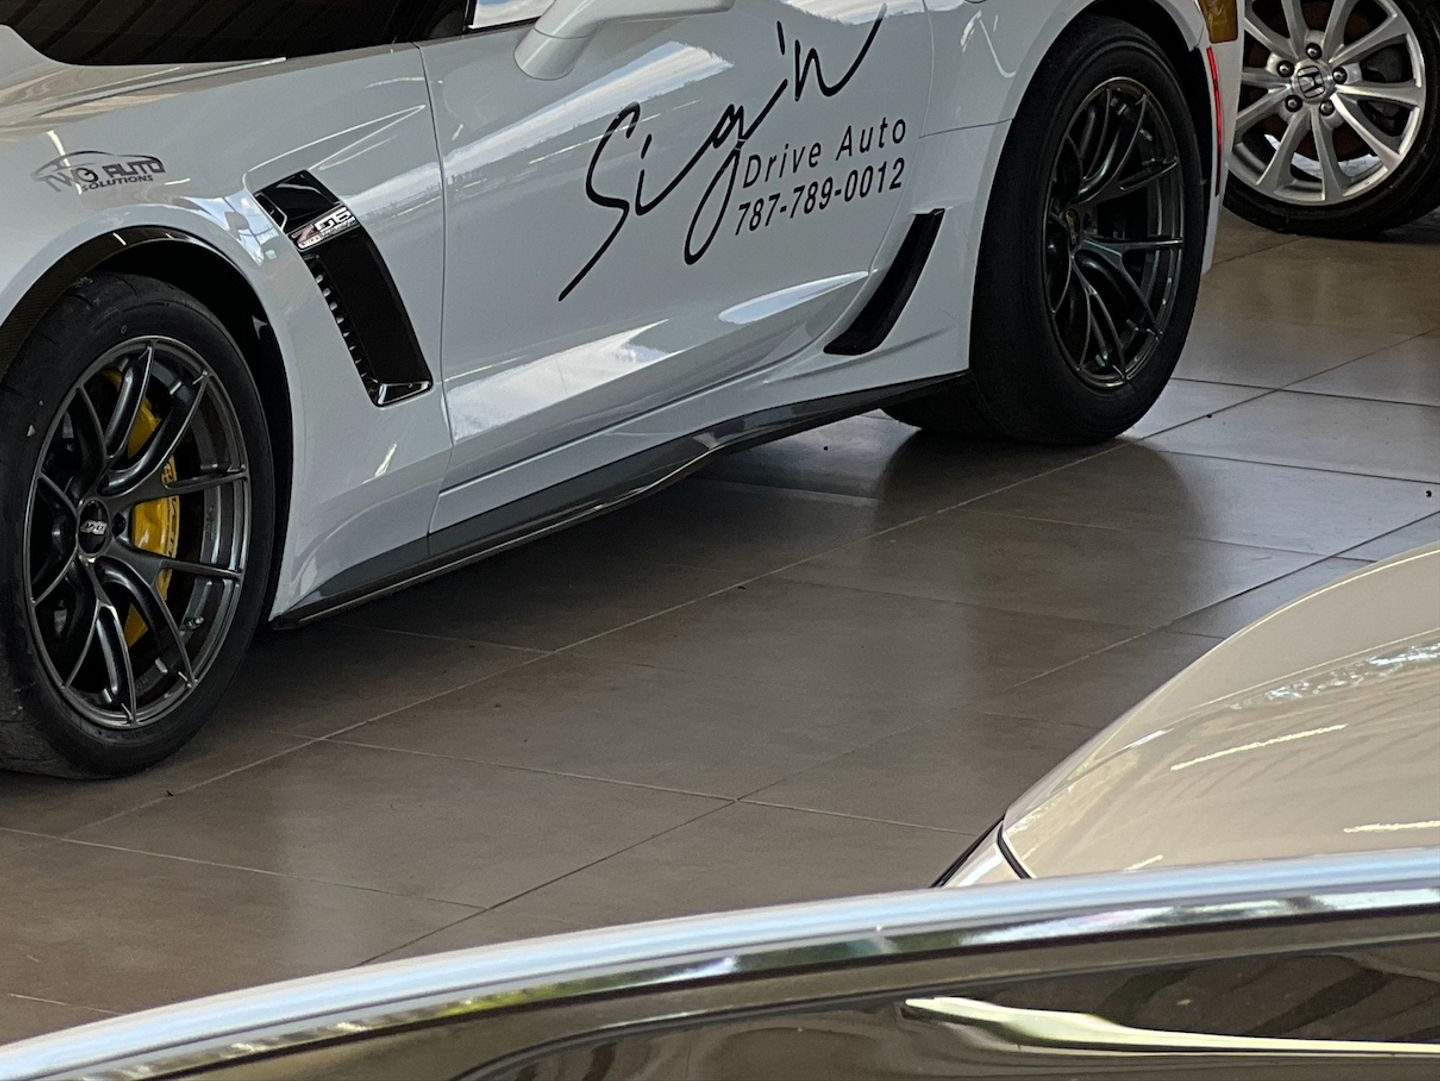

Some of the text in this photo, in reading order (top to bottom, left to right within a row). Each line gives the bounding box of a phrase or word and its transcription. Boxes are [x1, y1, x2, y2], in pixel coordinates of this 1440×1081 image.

[102, 159, 167, 179] AUTO
[743, 116, 907, 190] Drive Auto
[81, 174, 155, 193] SOLUTIONS
[734, 156, 906, 237] 787-789-0012
